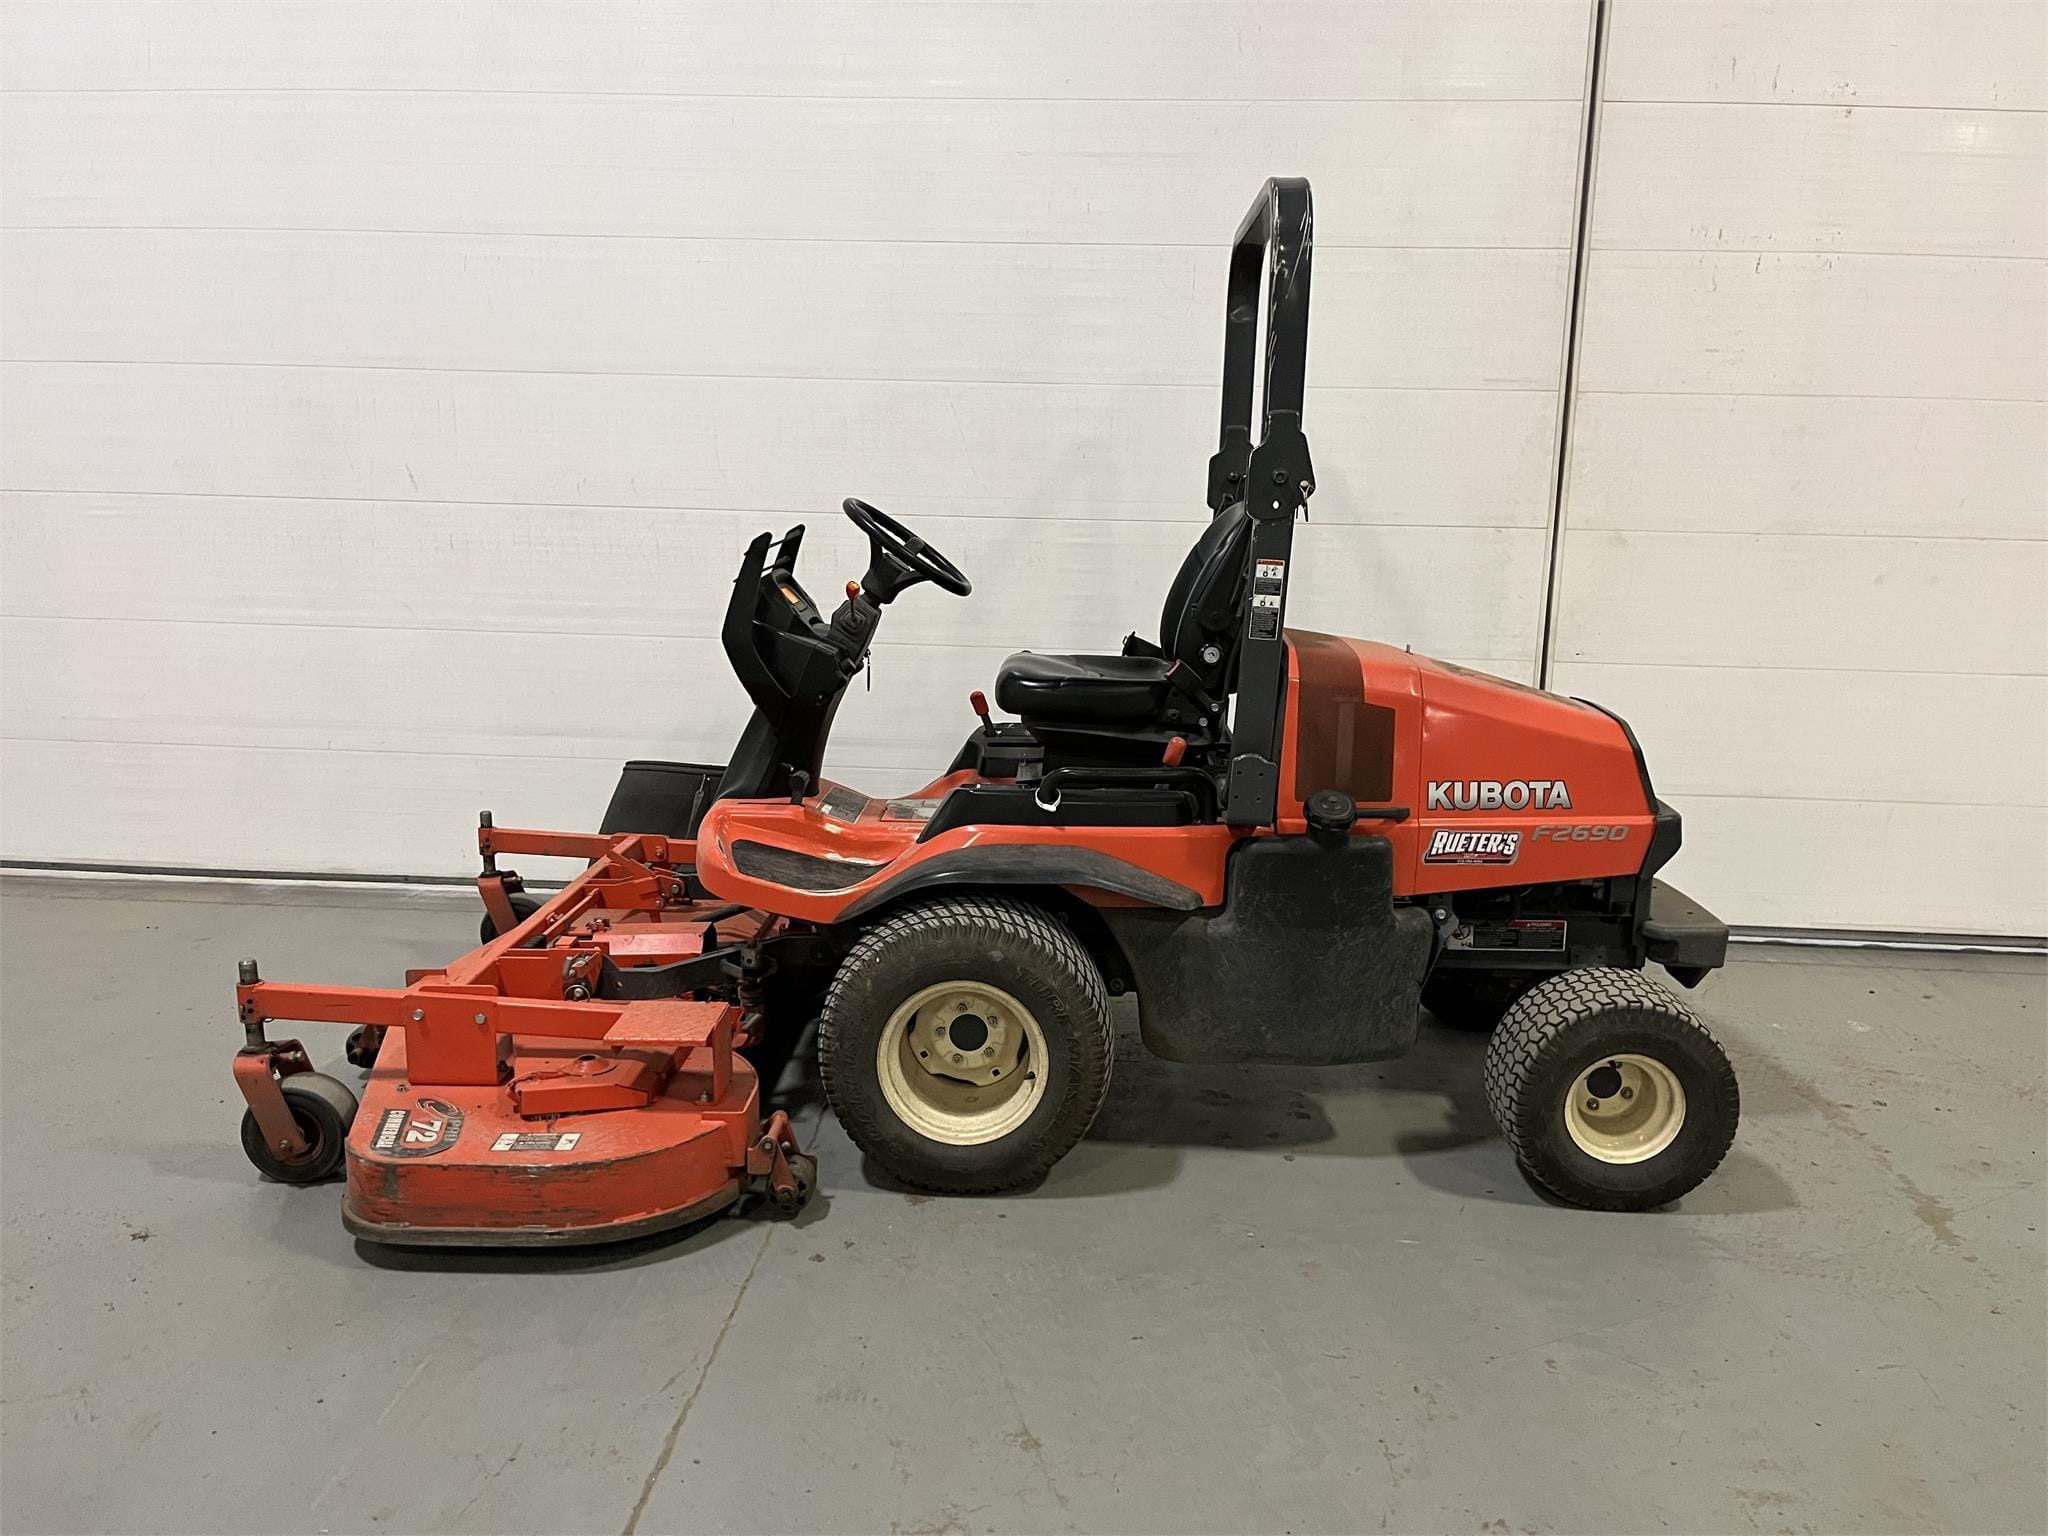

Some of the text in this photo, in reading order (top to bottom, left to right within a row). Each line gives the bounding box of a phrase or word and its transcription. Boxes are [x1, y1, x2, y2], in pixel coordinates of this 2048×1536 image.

[1427, 780, 1572, 811] KUBOTA
[1430, 831, 1520, 857] RUETER'S
[1532, 825, 1630, 842] F2690
[405, 1120, 443, 1143] 72
